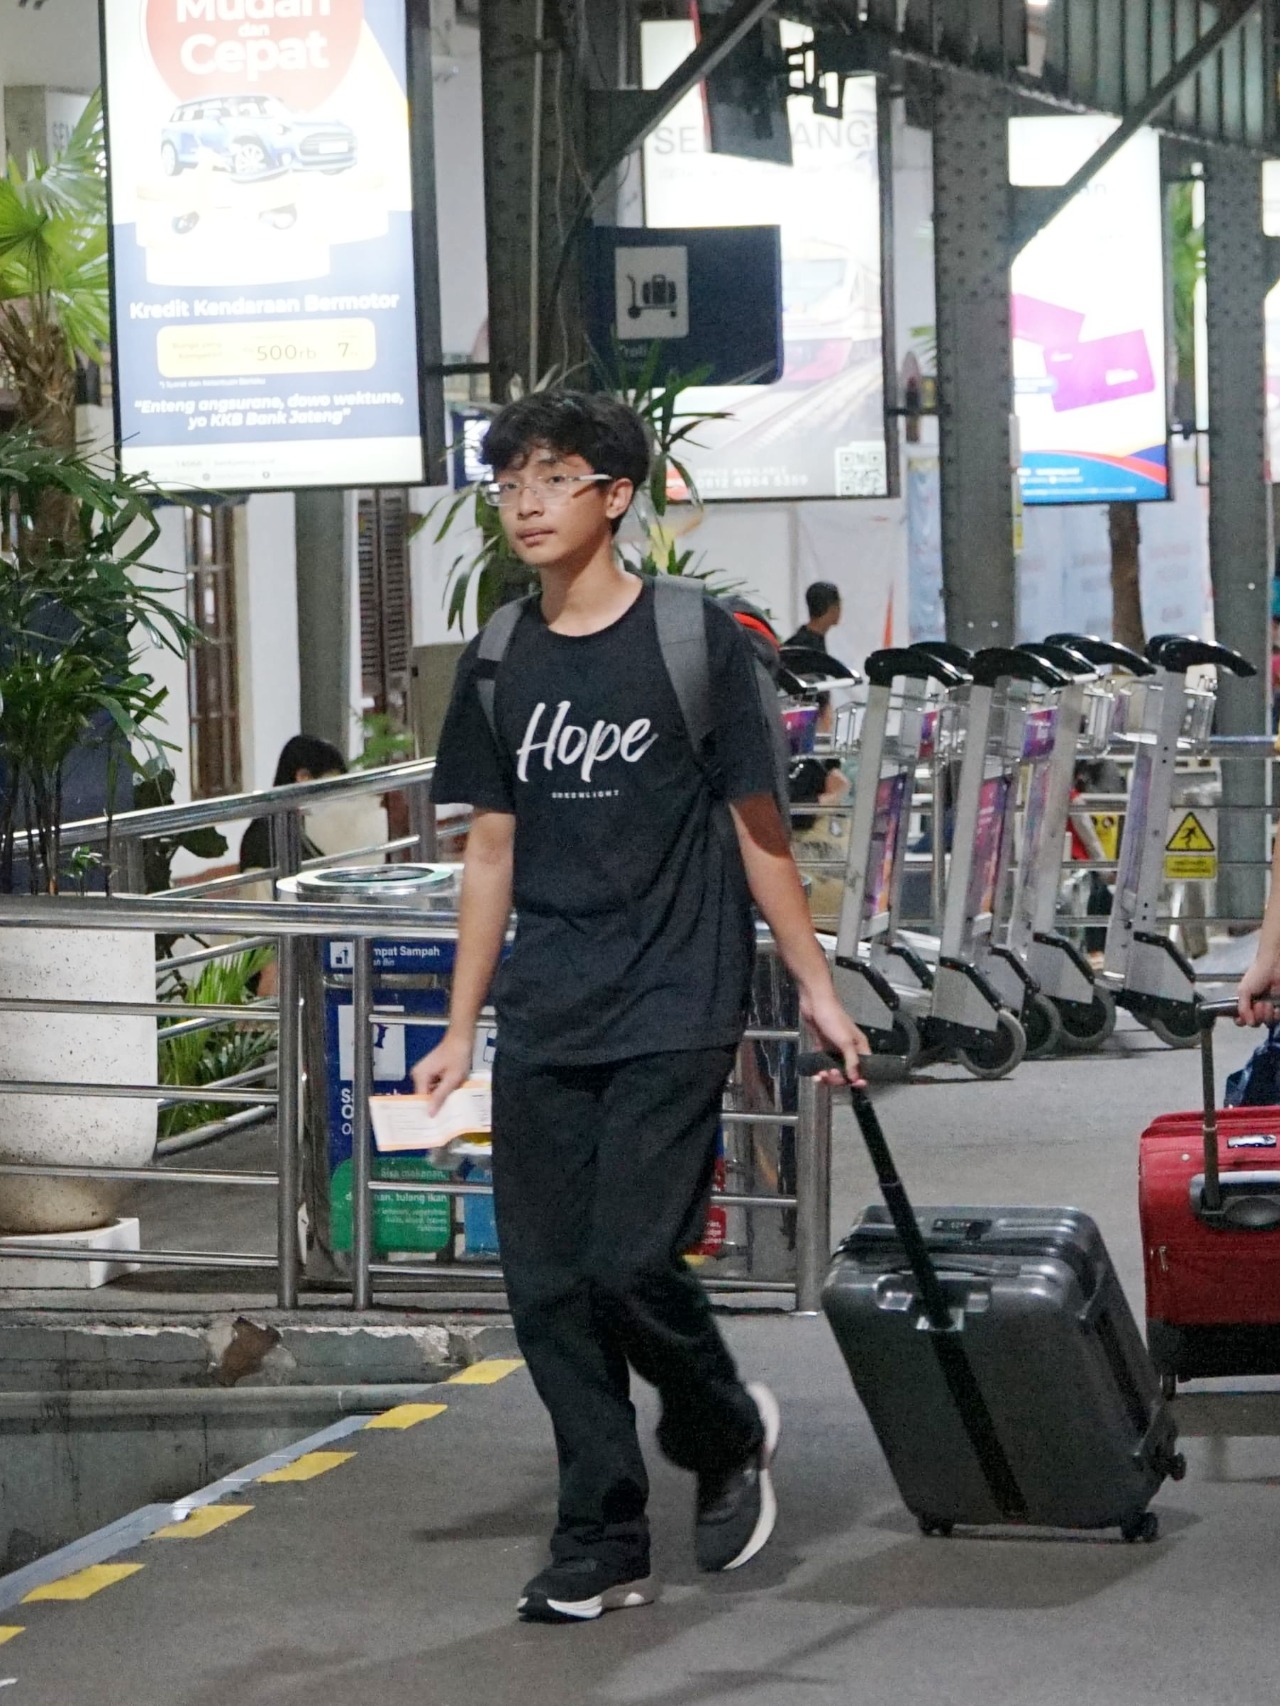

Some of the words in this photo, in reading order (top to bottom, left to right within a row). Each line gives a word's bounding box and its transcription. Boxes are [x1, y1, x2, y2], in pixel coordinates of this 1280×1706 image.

[238, 22, 270, 37] dan
[180, 30, 331, 82] Cepat
[654, 119, 871, 155] SEANG
[130, 300, 190, 319] Kredit
[194, 297, 300, 317] Kendaraan
[304, 293, 400, 313] Bermotor
[187, 416, 208, 431] yo
[210, 412, 244, 427] KKB
[245, 410, 287, 426] Bank
[516, 700, 659, 782] Hope
[399, 945, 440, 959] Sampah
[396, 1193, 425, 1206] tulang
[427, 1192, 448, 1203] ikan
